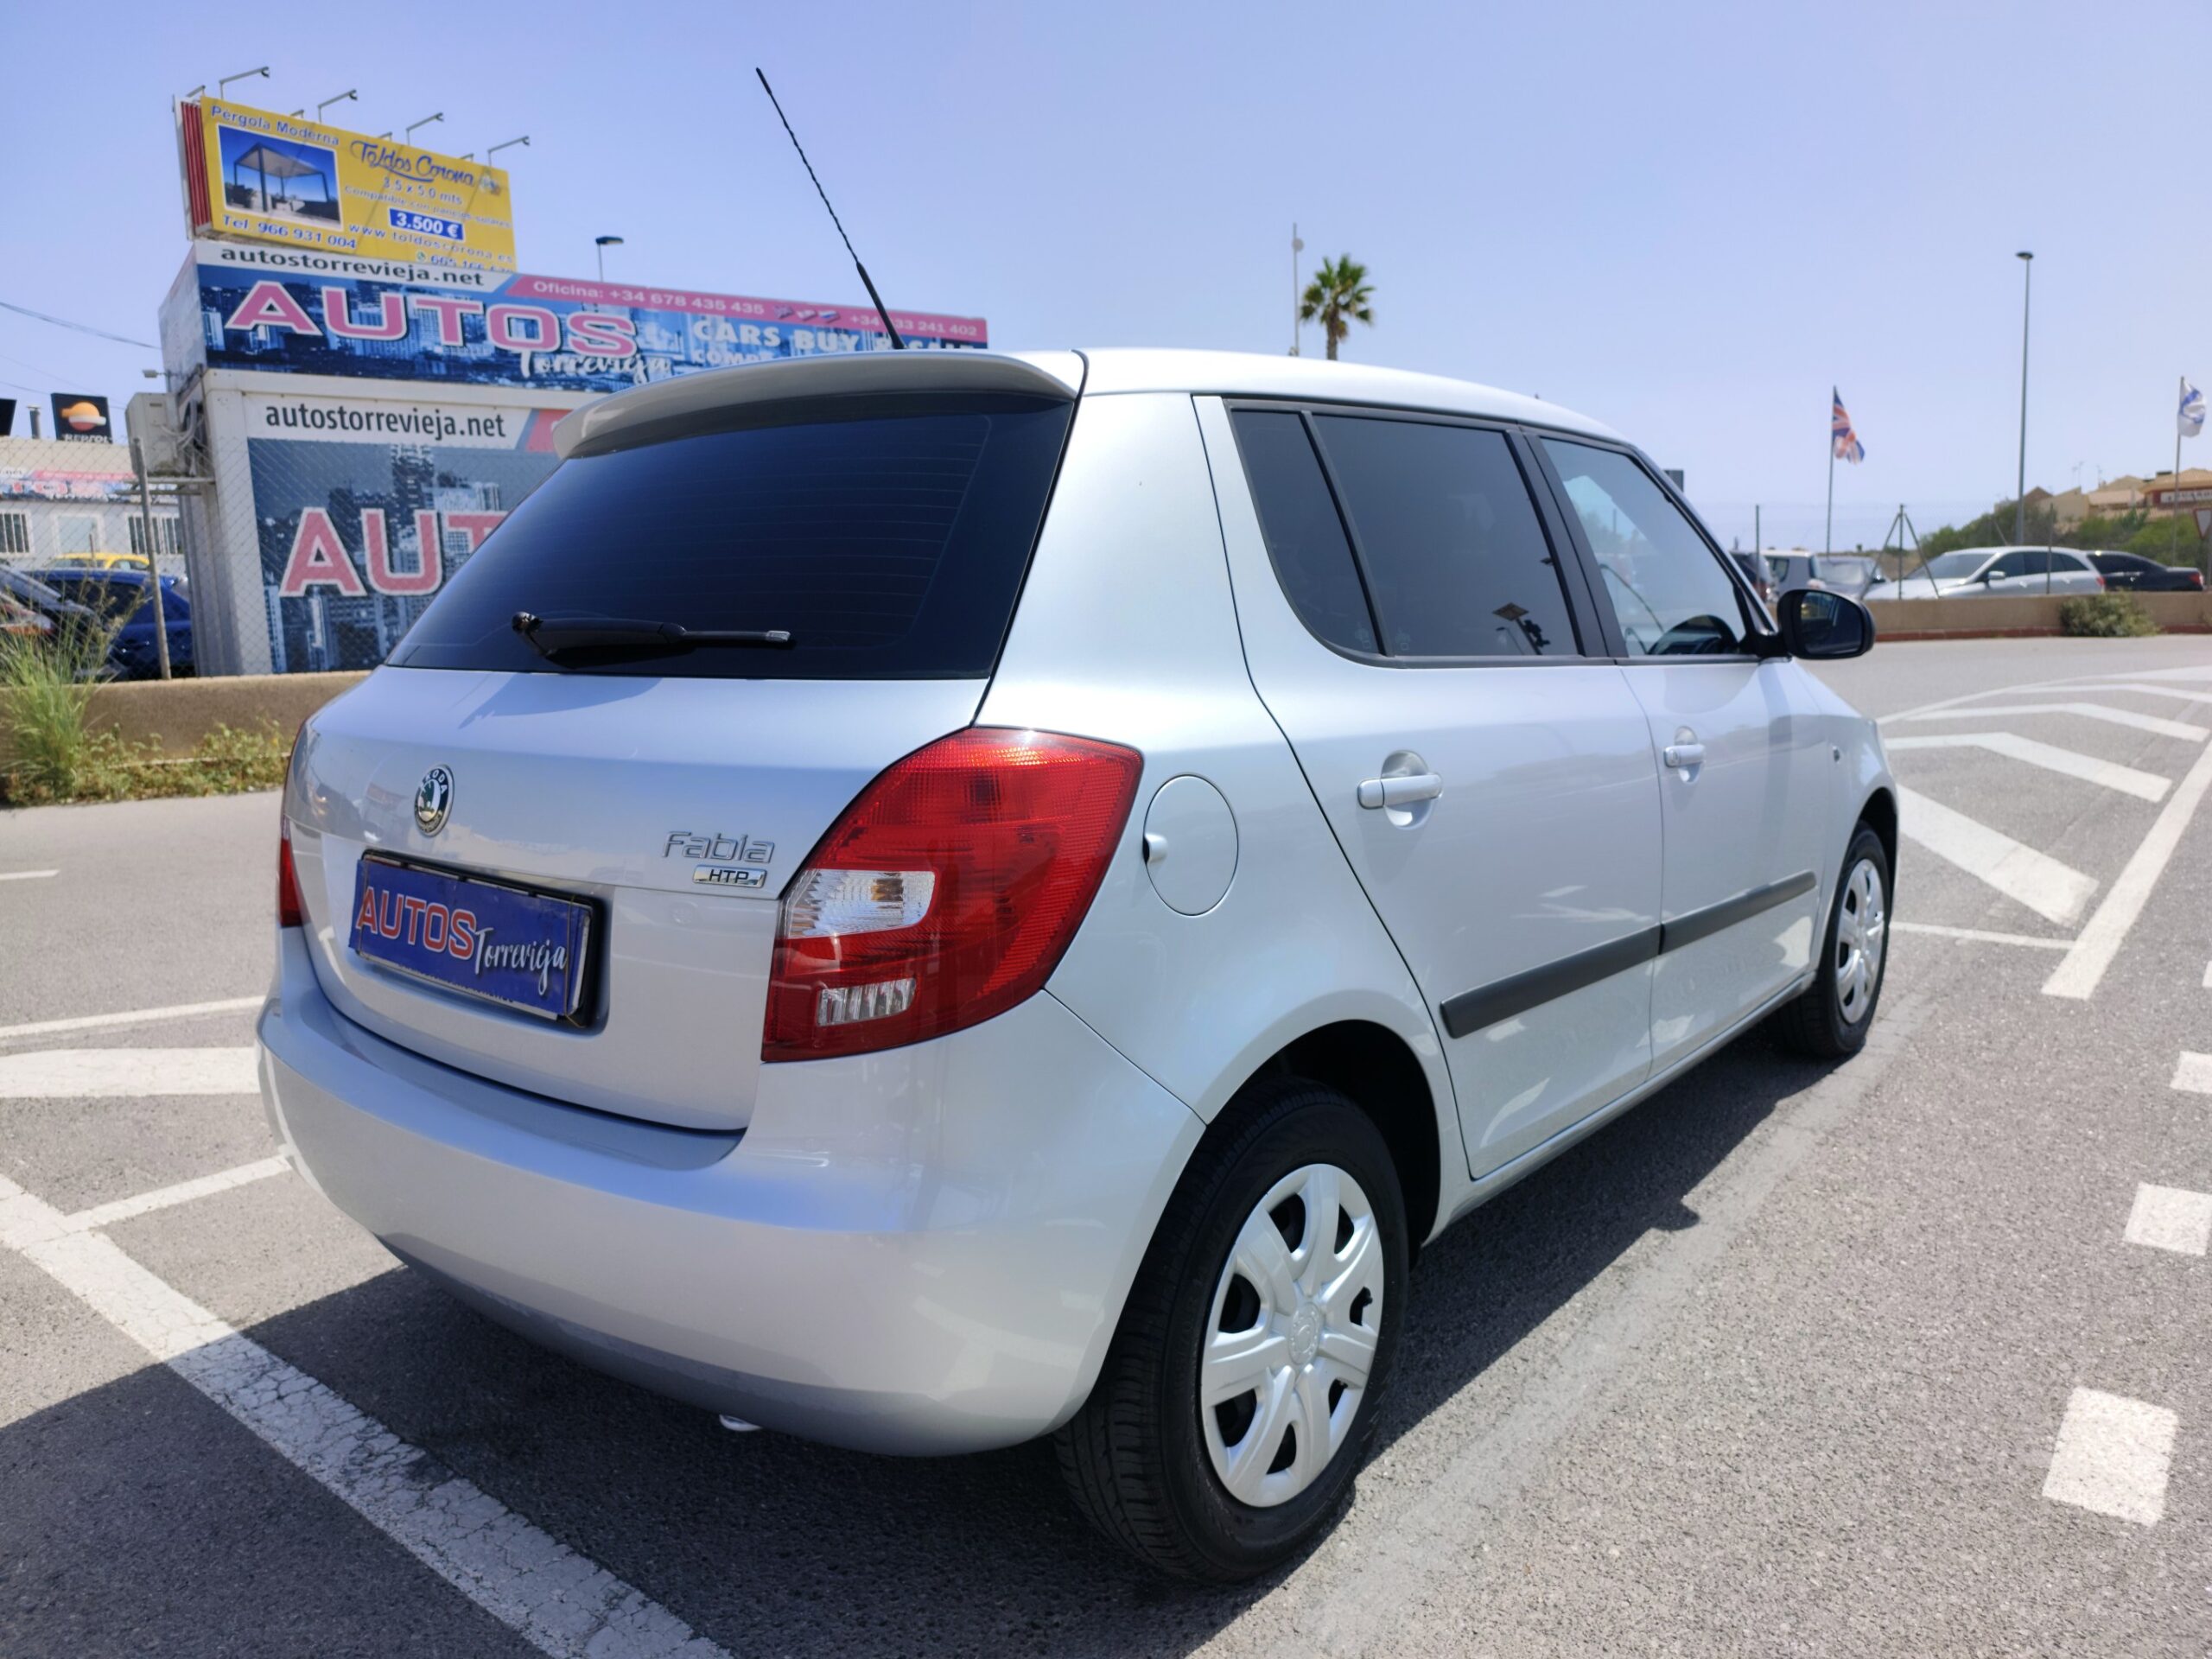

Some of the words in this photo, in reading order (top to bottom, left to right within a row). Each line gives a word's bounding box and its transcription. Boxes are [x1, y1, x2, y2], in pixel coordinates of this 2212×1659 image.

[276, 121, 340, 146] Moderna
[350, 140, 412, 173] Toldos
[416, 155, 474, 187] Corona
[258, 222, 289, 237] 966
[293, 228, 322, 243] 931
[327, 234, 357, 250] 004
[396, 212, 443, 235] 3.500
[447, 223, 460, 239] €
[221, 248, 485, 287] autostorrevieja.net
[533, 280, 604, 299] Oficina:
[608, 289, 645, 303] +34
[651, 294, 687, 308] 678
[691, 297, 727, 311] 435
[731, 301, 765, 315] 435
[225, 280, 638, 359] AUTOS
[692, 319, 781, 347] CARS
[793, 329, 861, 352] BUY
[850, 315, 880, 327] +34
[885, 318, 914, 330] 33
[918, 321, 946, 334] 241
[949, 326, 977, 336] 402
[265, 404, 507, 441] autostorrevieja.net
[661, 830, 776, 864] Fabia
[709, 868, 750, 883] HTP
[355, 886, 477, 961] AUTOS
[474, 927, 568, 995] Torrevieja
